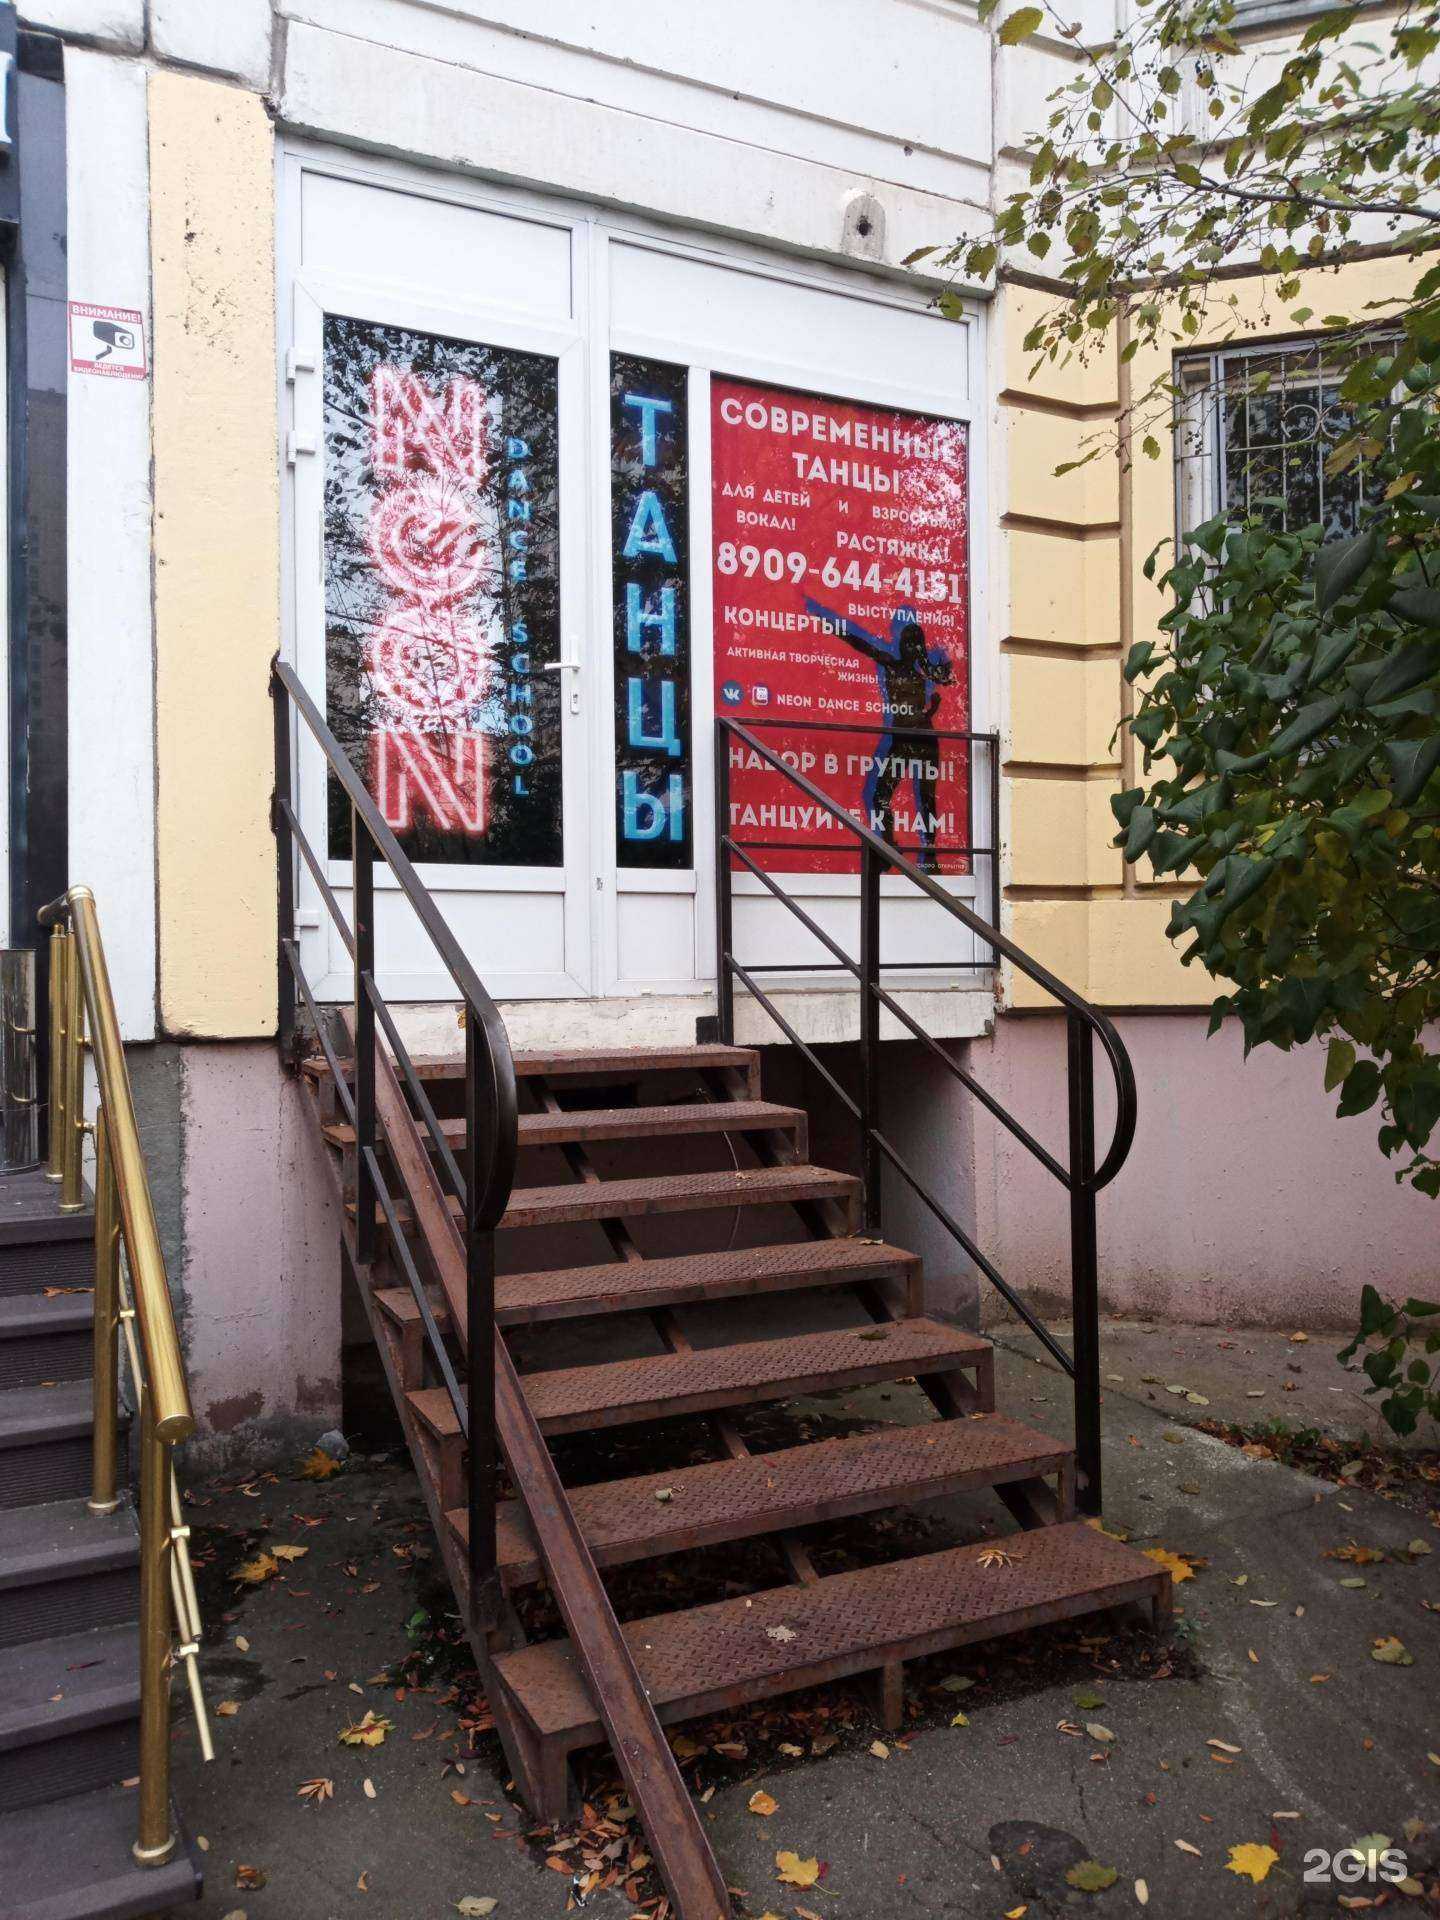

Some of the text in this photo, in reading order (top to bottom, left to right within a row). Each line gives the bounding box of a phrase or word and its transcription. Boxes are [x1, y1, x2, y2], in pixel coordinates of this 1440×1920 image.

[72, 305, 141, 322] ВНИМАНИЕ!
[792, 452, 900, 495] ТАНЦЫ
[721, 482, 756, 500] ДЛЯ
[763, 489, 811, 508] ДЕТЕЙ
[838, 500, 849, 514] И
[736, 510, 796, 531] ВОКАЛ!
[836, 531, 950, 562] РАСТЯЖКА!
[717, 541, 962, 604] 8909-644-4151
[371, 363, 487, 833] NEON
[508, 437, 533, 796] DANCE SCHOOL
[621, 392, 686, 842] ТАНЦЫ
[724, 605, 848, 636] КОНЦЕРТЫ!
[848, 603, 955, 627] ВЫСТУПЛЕНИЯ!
[727, 647, 860, 669] АКТИВНАЯ ТВОРЧЕСКАЯ
[824, 753, 839, 775] В
[847, 755, 954, 782] ГРУППЫ!
[870, 810, 886, 831] К
[894, 810, 954, 834] НАМ!
